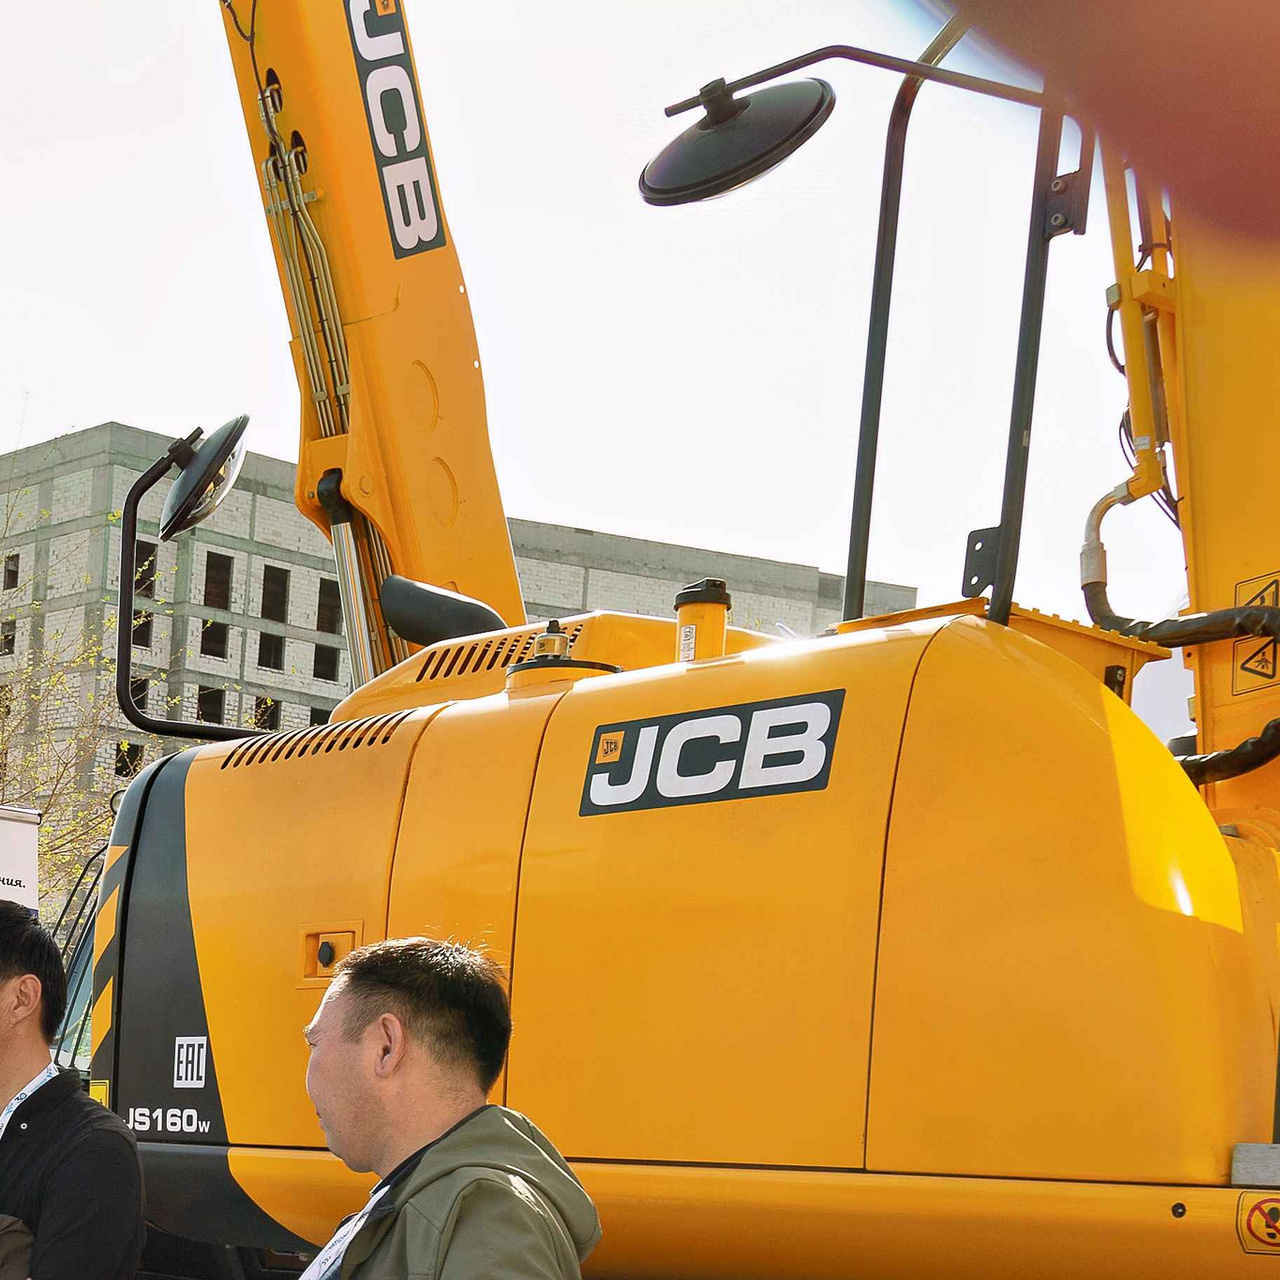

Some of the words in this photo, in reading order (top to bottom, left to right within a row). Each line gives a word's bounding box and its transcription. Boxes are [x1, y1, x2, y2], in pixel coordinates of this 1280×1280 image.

[349, 0, 438, 250] JCB
[589, 702, 832, 806] JCB
[176, 1043, 205, 1081] EAC
